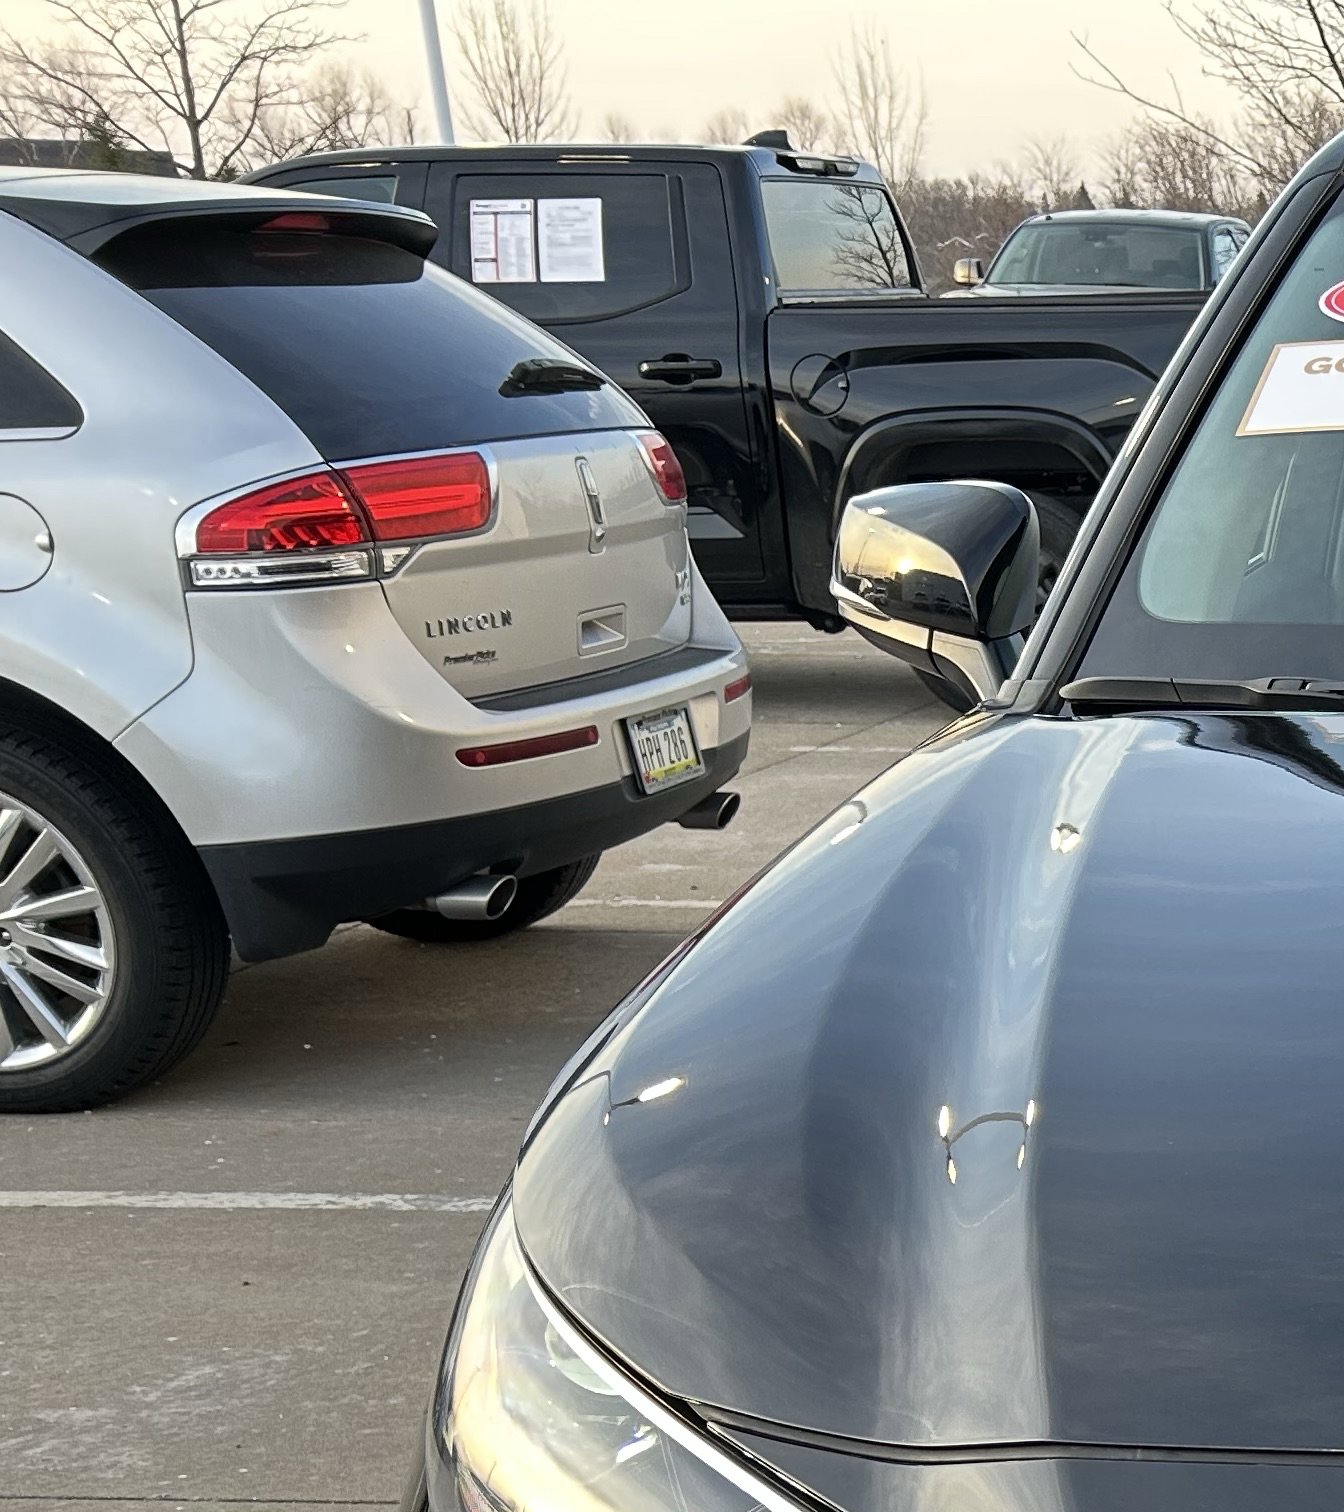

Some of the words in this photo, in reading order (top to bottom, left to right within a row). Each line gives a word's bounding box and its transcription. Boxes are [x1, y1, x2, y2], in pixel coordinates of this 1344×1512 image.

[424, 608, 513, 638] LINCOLN
[637, 733, 666, 771] HPH
[663, 726, 689, 765] 286
